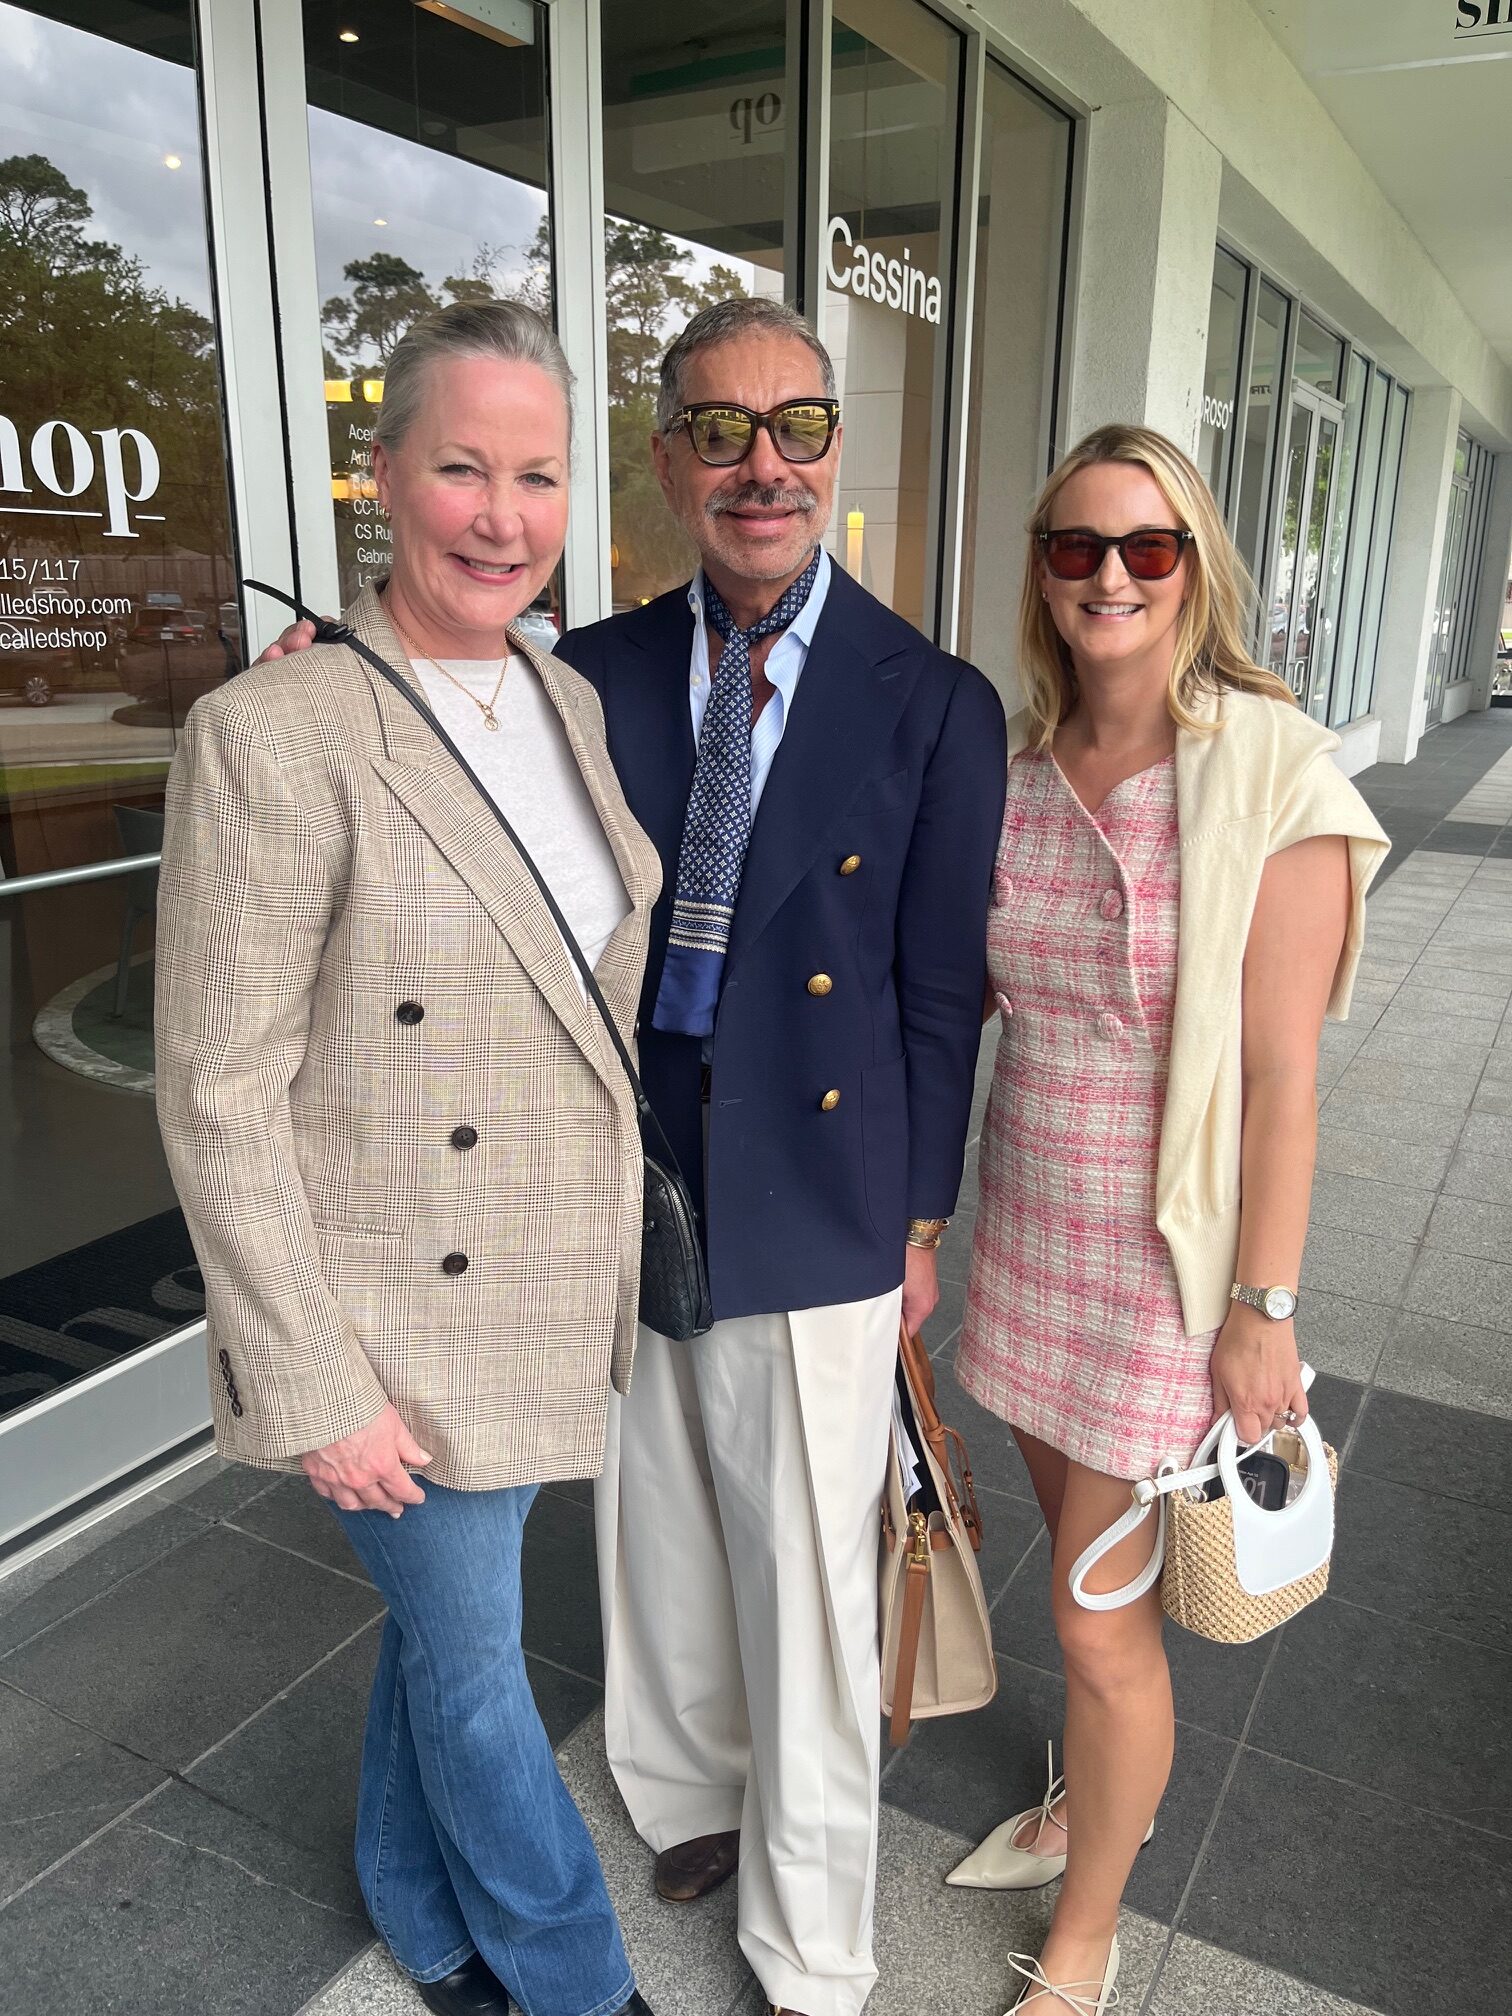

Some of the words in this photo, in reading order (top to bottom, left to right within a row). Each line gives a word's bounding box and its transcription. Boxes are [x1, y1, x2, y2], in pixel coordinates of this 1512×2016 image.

[826, 215, 942, 325] Cassina
[1201, 394, 1229, 431] ROSO
[348, 423, 376, 442] Acer
[354, 523, 373, 540] CS
[0, 558, 81, 585] 15/117
